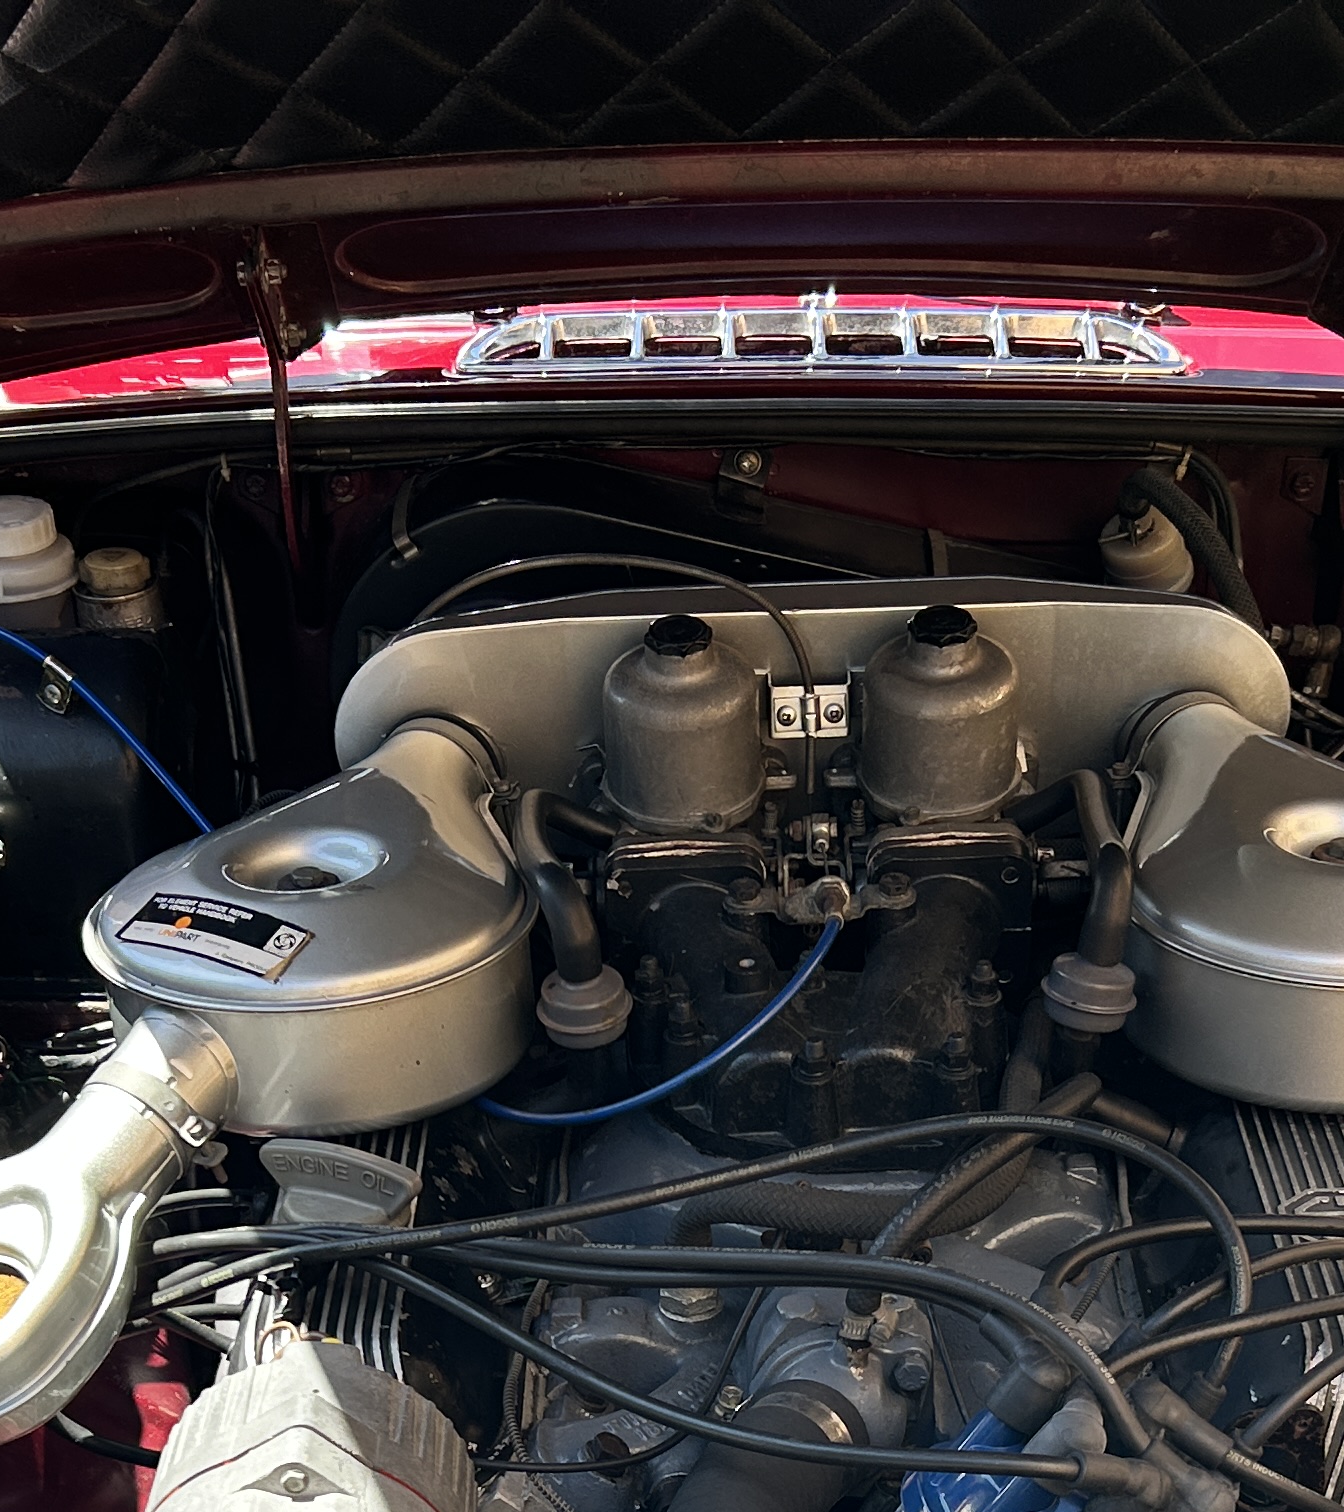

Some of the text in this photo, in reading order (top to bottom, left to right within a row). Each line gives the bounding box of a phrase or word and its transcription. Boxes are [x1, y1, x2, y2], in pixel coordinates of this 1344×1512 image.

[158, 929, 202, 942] UNIPART
[271, 1153, 395, 1196] ENGINE OIL
